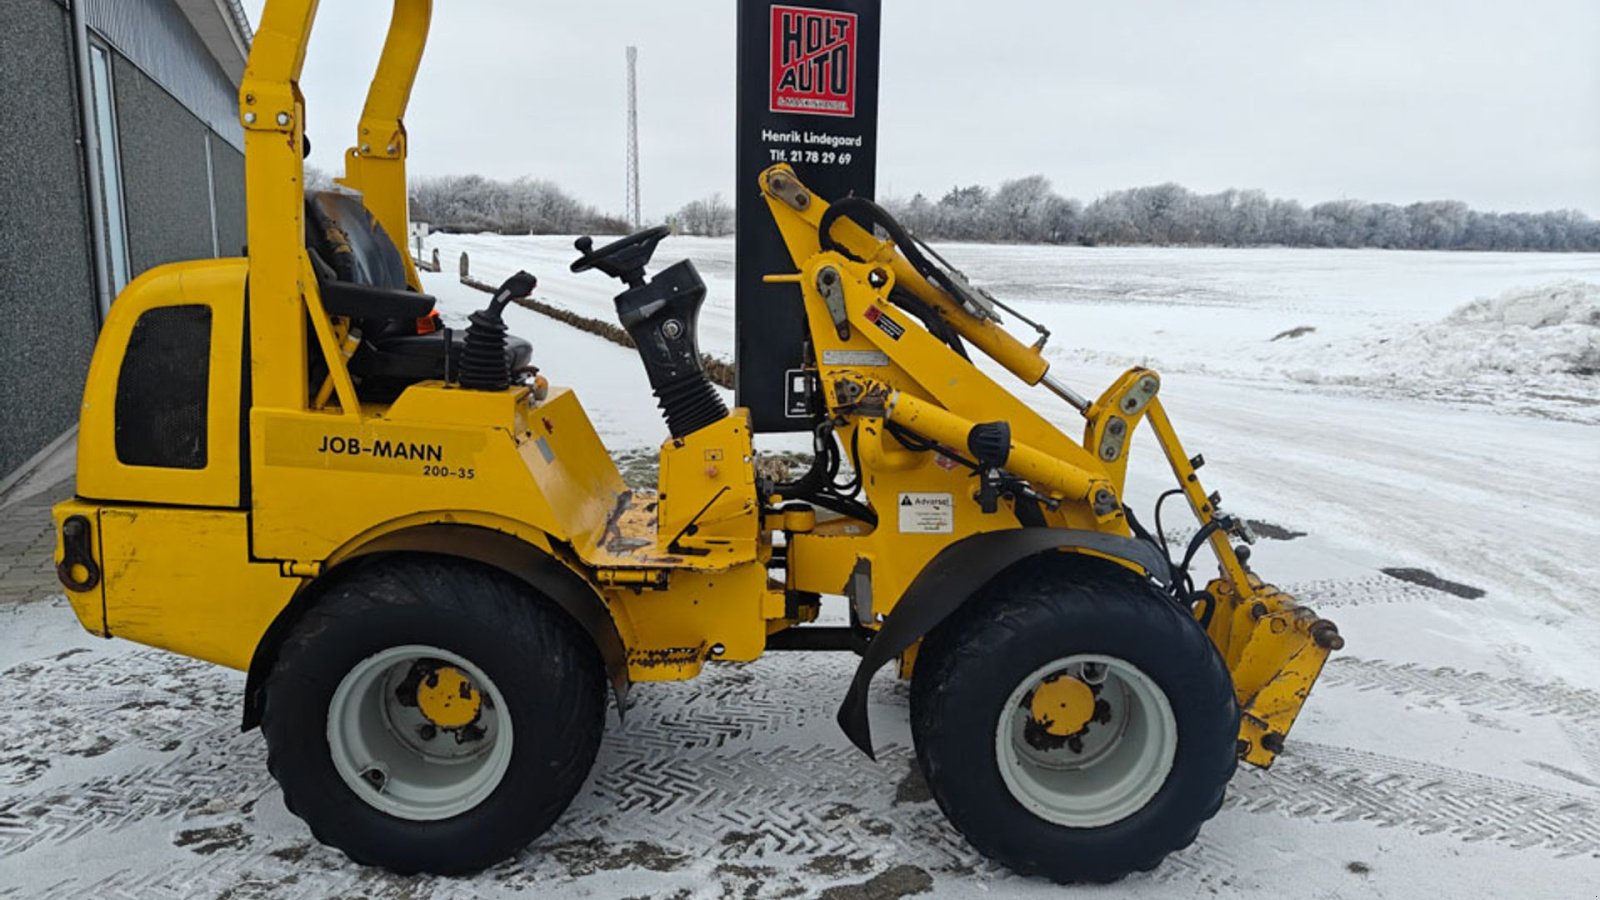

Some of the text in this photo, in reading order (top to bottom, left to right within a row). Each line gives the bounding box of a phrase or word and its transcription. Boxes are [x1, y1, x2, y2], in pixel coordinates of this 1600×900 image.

[782, 12, 849, 67] HOLT
[777, 43, 849, 95] AUTO
[762, 129, 801, 143] Henrik
[790, 150, 802, 162] 21
[805, 151, 819, 163] 78
[821, 152, 836, 164] 29
[838, 153, 852, 165] 69
[318, 435, 443, 462] JOB-MANN
[423, 465, 475, 479] 200-35
